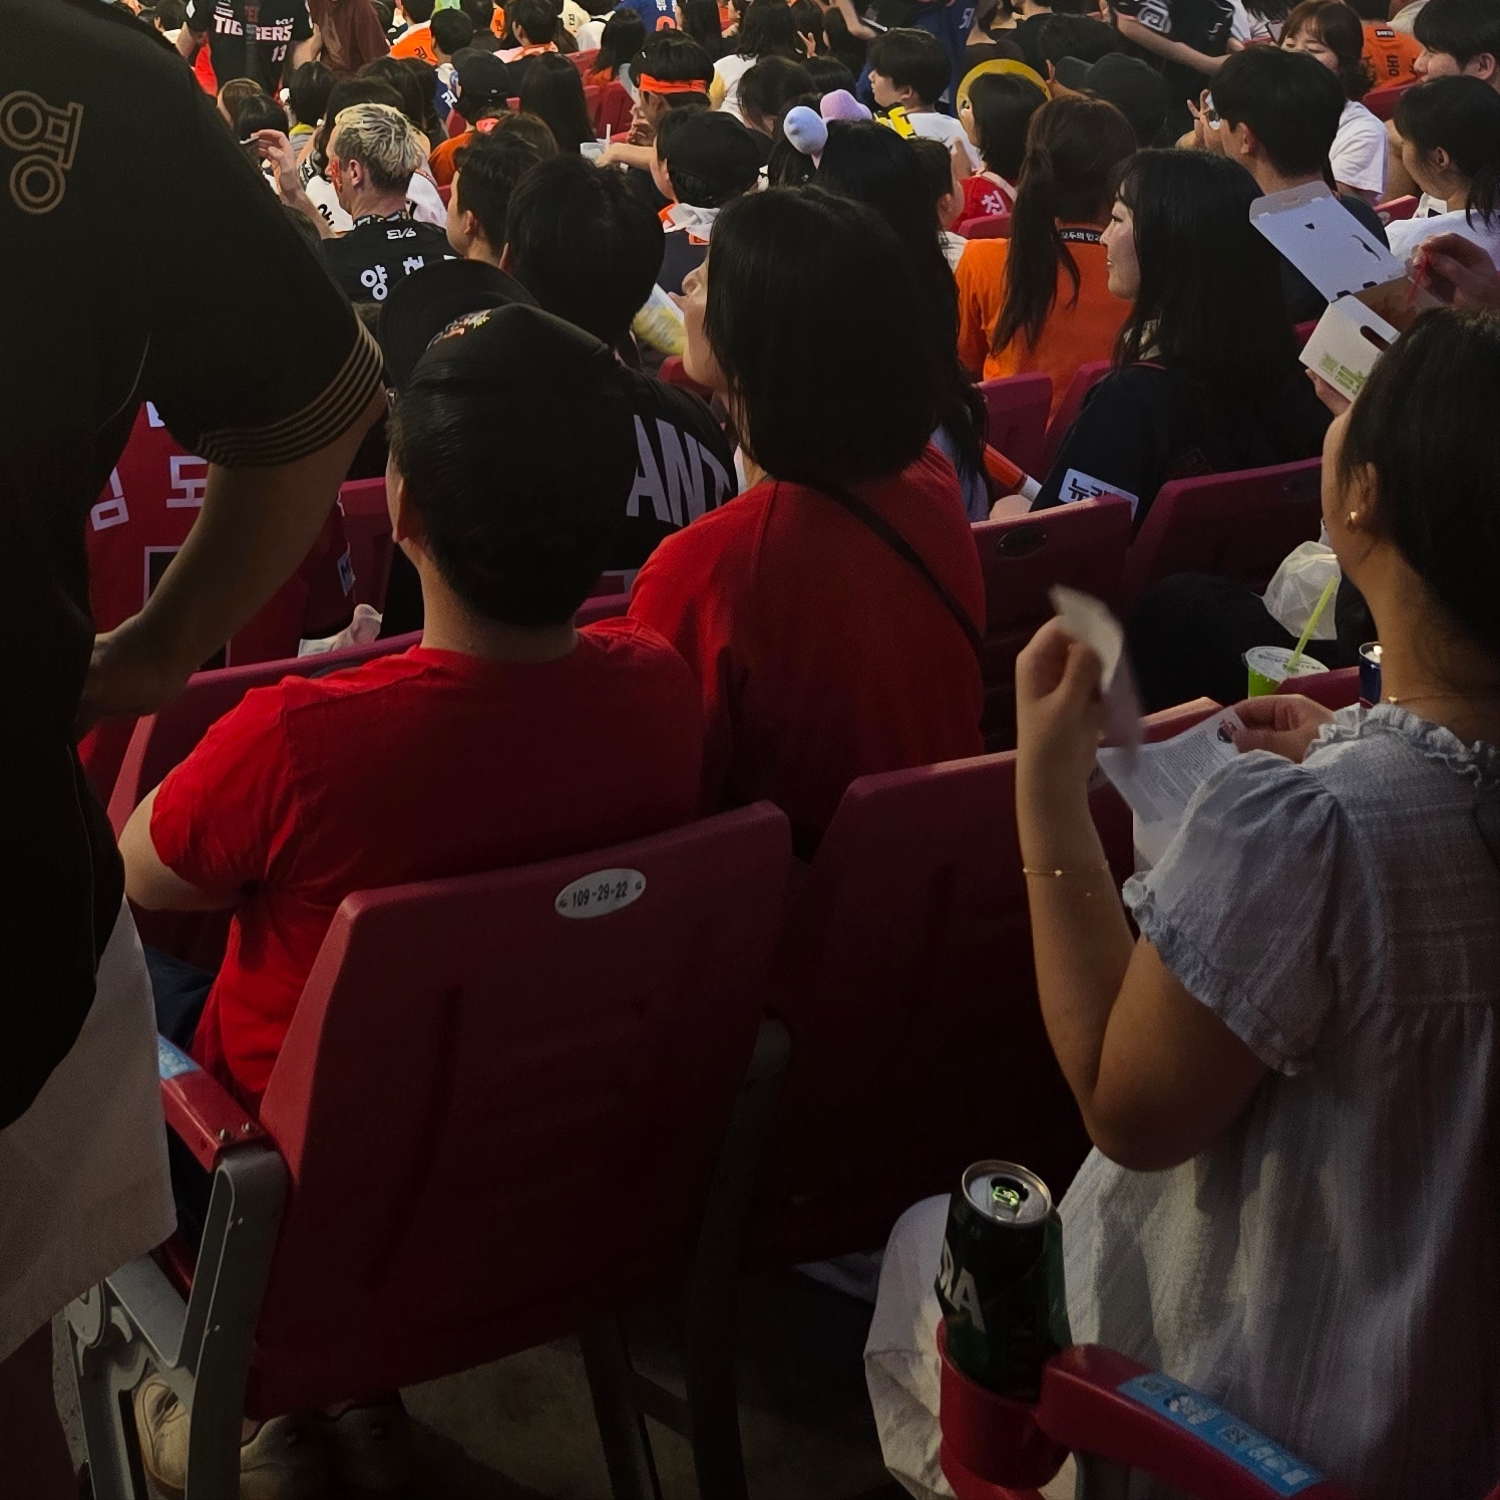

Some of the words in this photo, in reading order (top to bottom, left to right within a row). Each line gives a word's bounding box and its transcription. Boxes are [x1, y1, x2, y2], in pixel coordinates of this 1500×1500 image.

[213, 14, 293, 42] TIGERS
[271, 44, 288, 62] 13
[572, 881, 629, 908] 109-29-22
